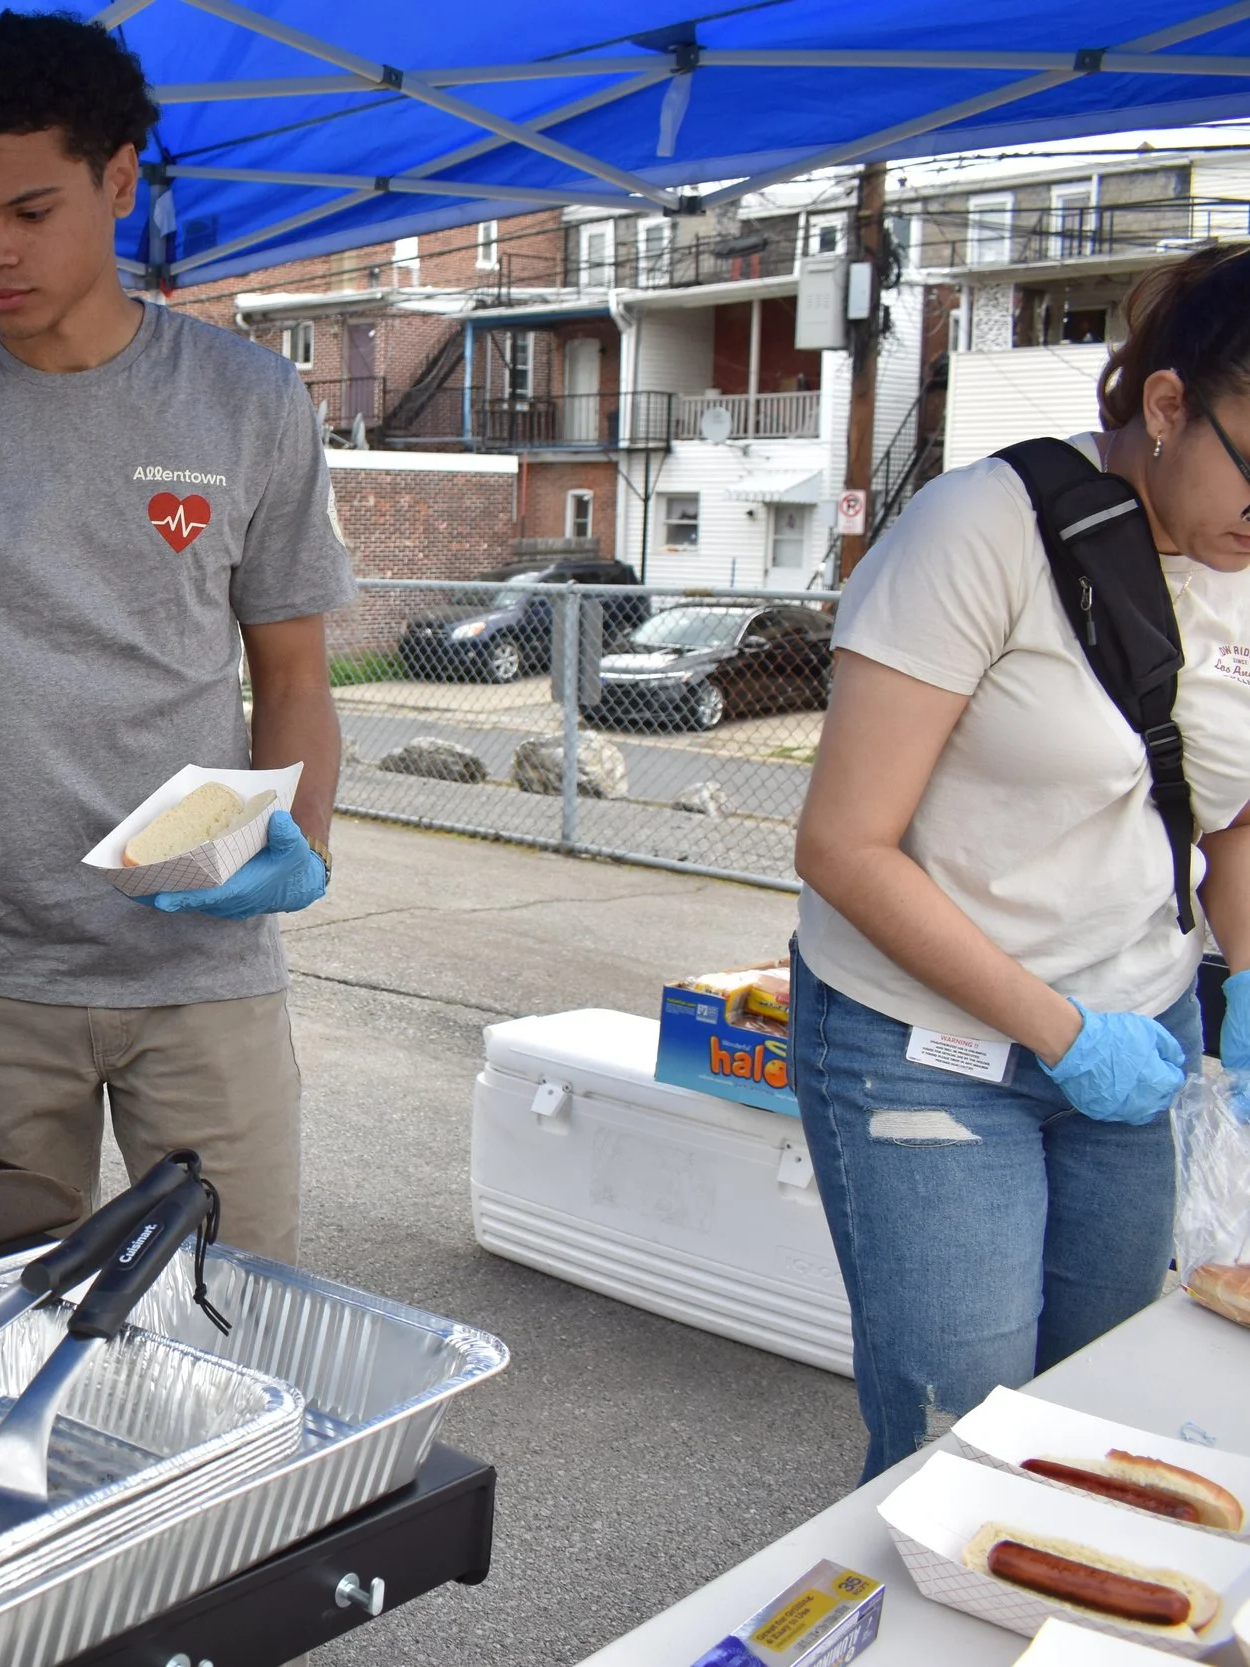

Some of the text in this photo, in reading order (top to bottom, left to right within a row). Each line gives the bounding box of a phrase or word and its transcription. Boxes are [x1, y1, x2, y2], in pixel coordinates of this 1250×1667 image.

[132, 466, 227, 487] Allentown
[1214, 658, 1231, 674] Los
[941, 1035, 973, 1048] WARNING
[838, 1575, 862, 1592] 35
